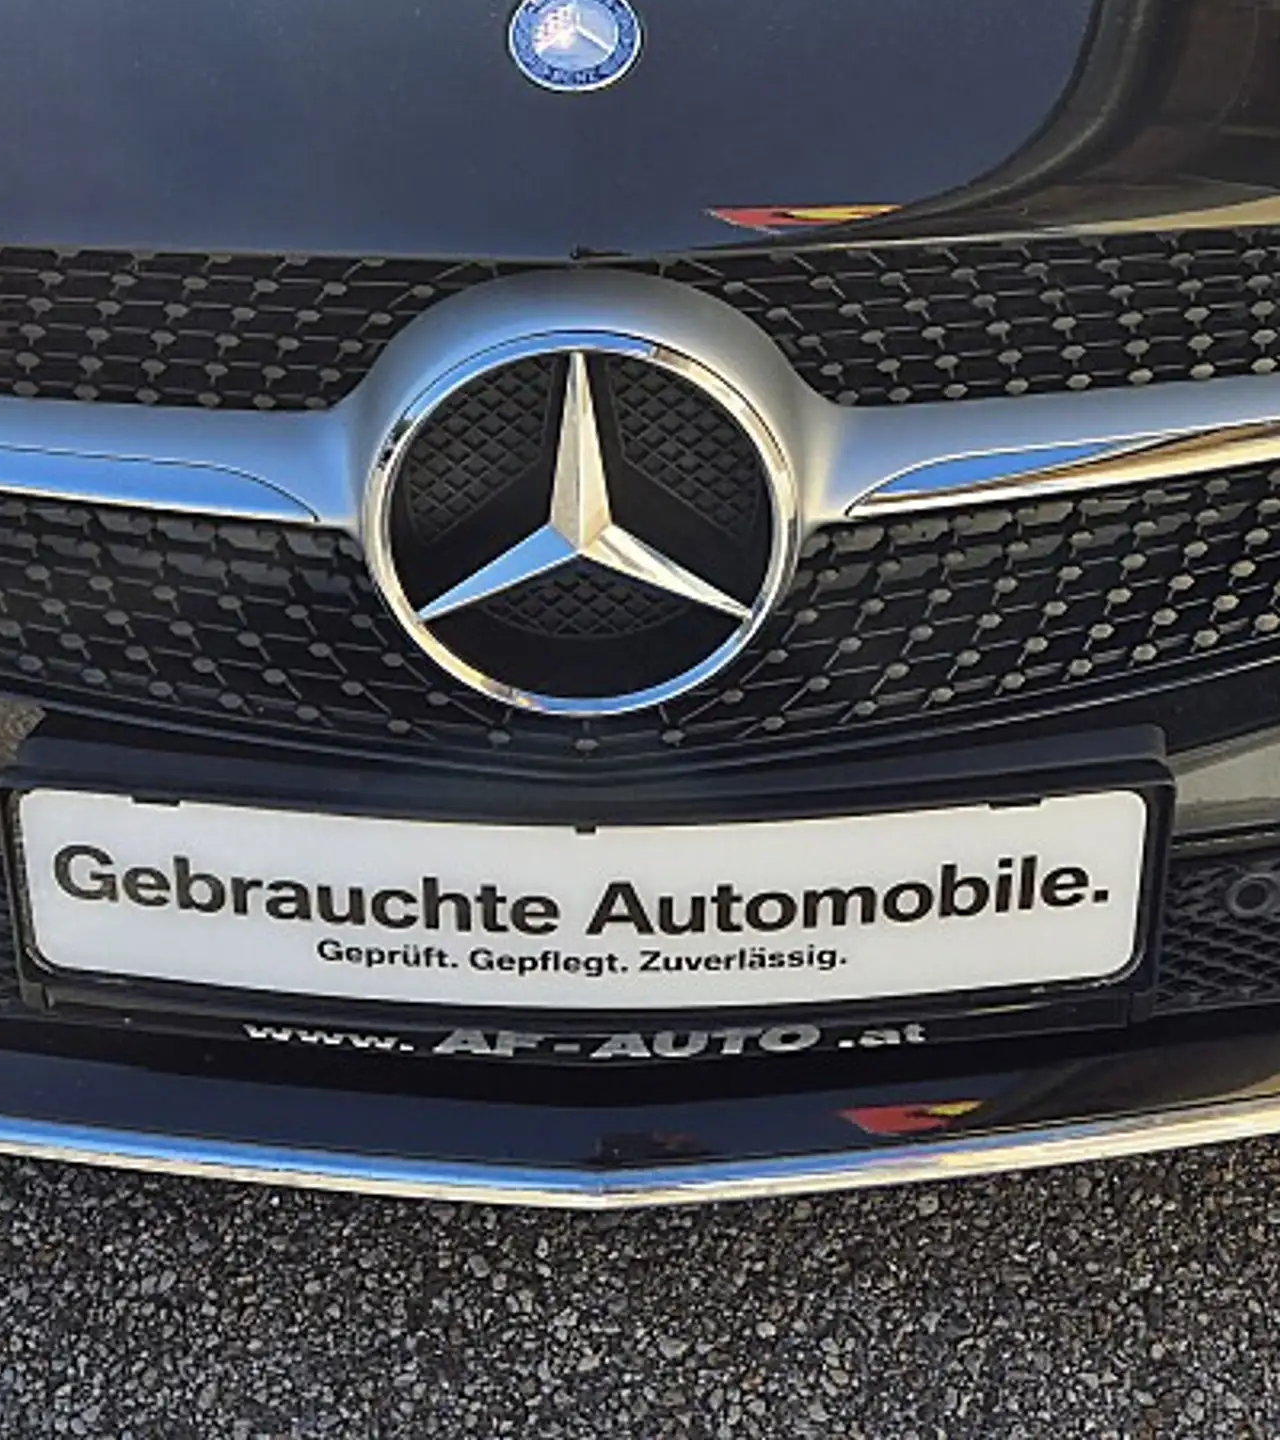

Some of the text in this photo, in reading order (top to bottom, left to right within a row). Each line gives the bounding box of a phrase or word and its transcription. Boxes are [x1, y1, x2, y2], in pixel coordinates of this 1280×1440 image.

[53, 844, 1110, 936] Gebrauchte Automobile.
[316, 938, 847, 977] Geprüft. Gepflegt. Zuverlässig.
